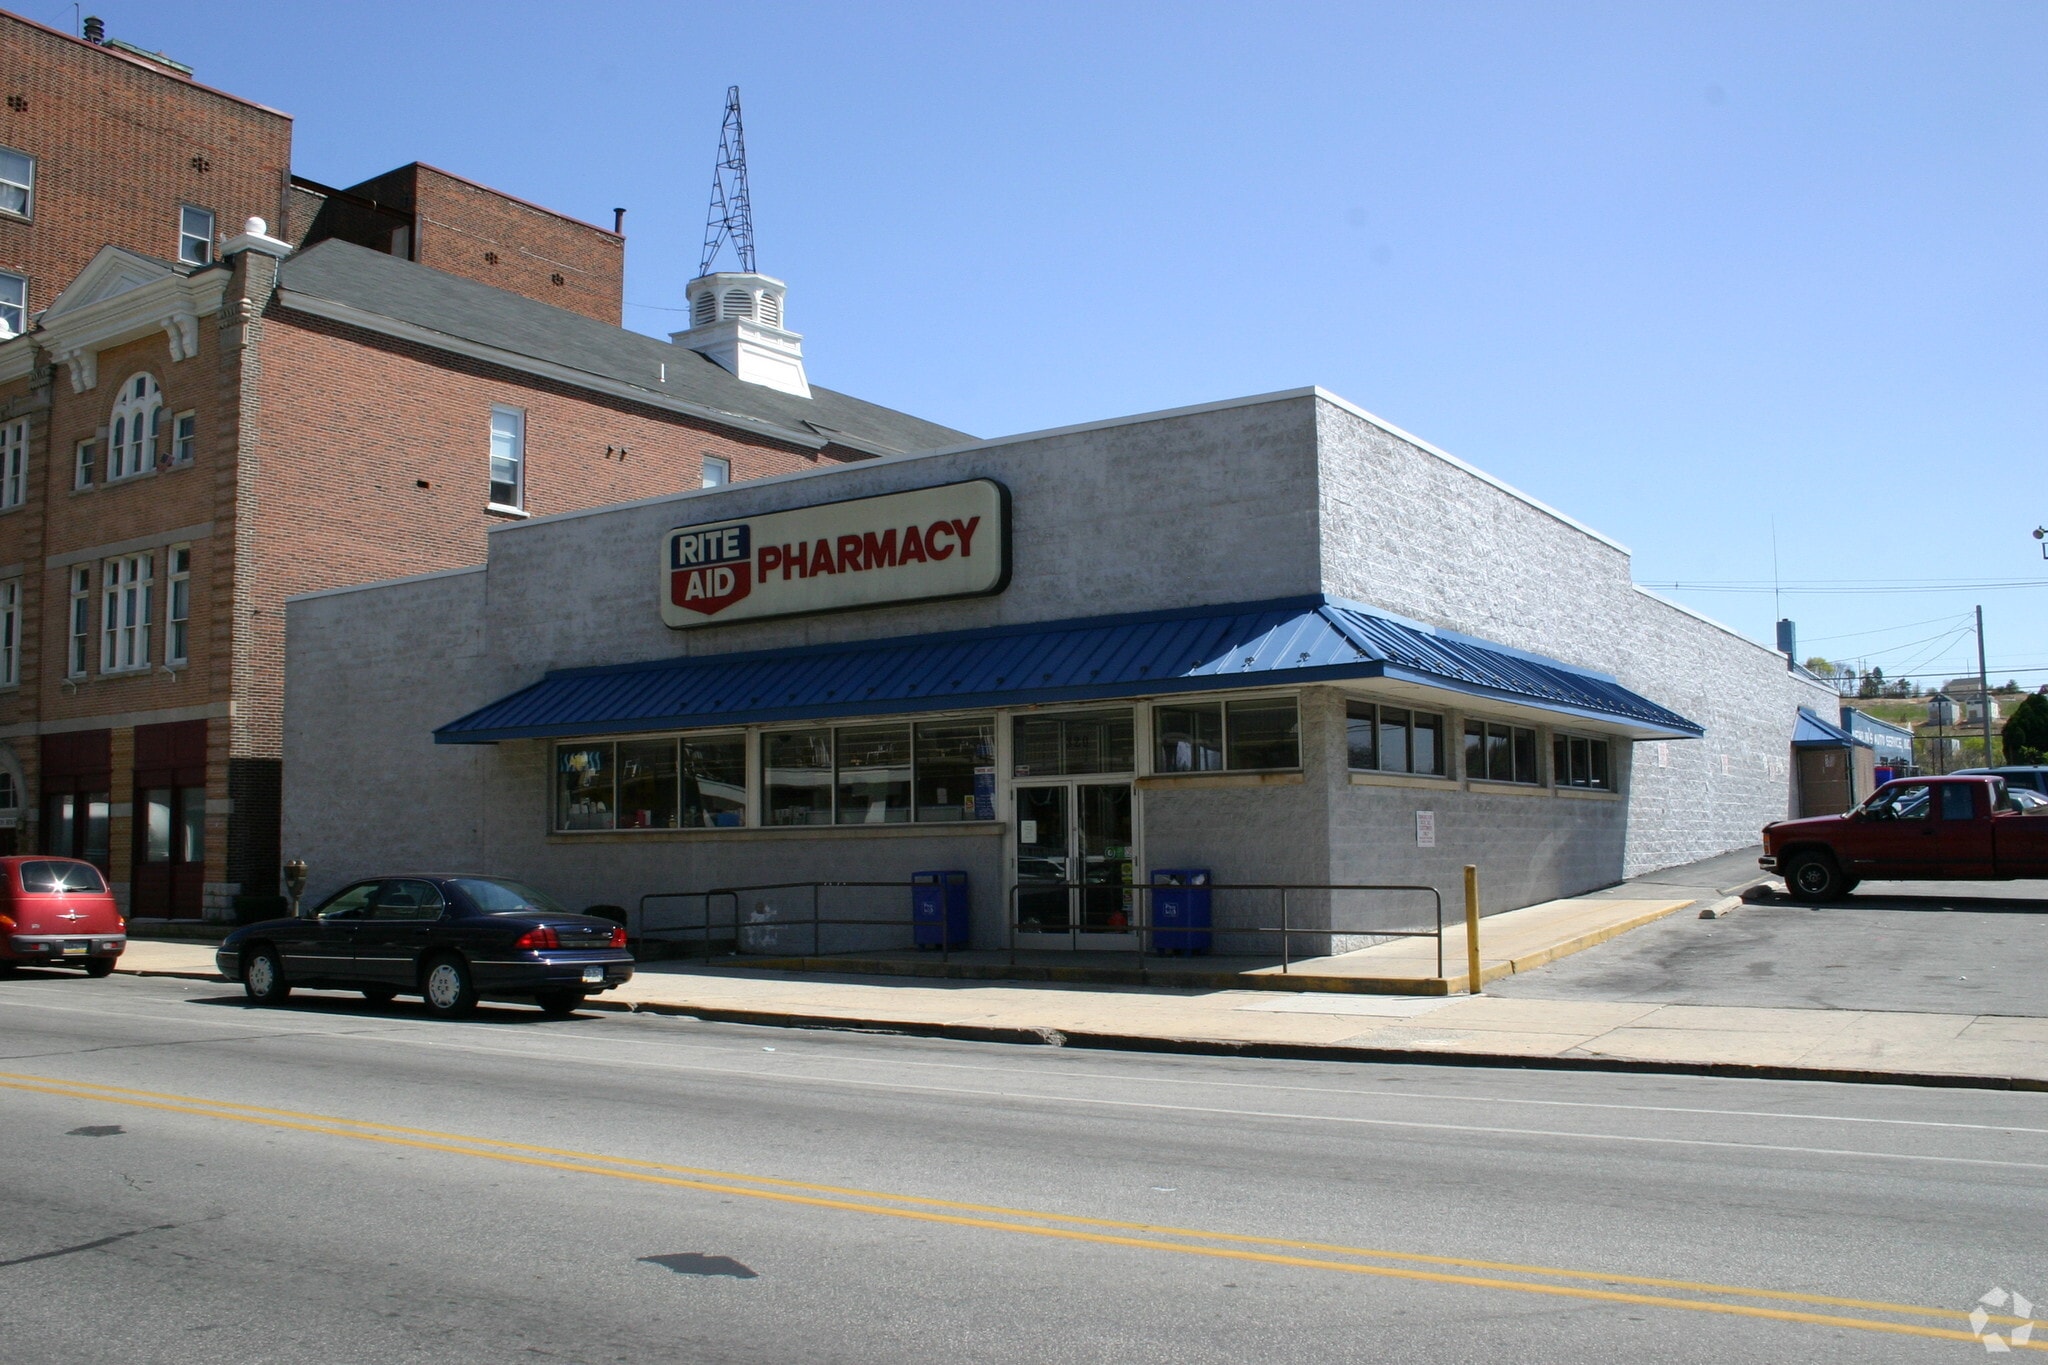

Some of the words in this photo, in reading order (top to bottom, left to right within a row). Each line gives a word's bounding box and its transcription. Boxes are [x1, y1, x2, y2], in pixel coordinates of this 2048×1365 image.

[679, 527, 740, 565] RITE
[758, 516, 981, 584] PHARMACY
[685, 567, 736, 601] AID
